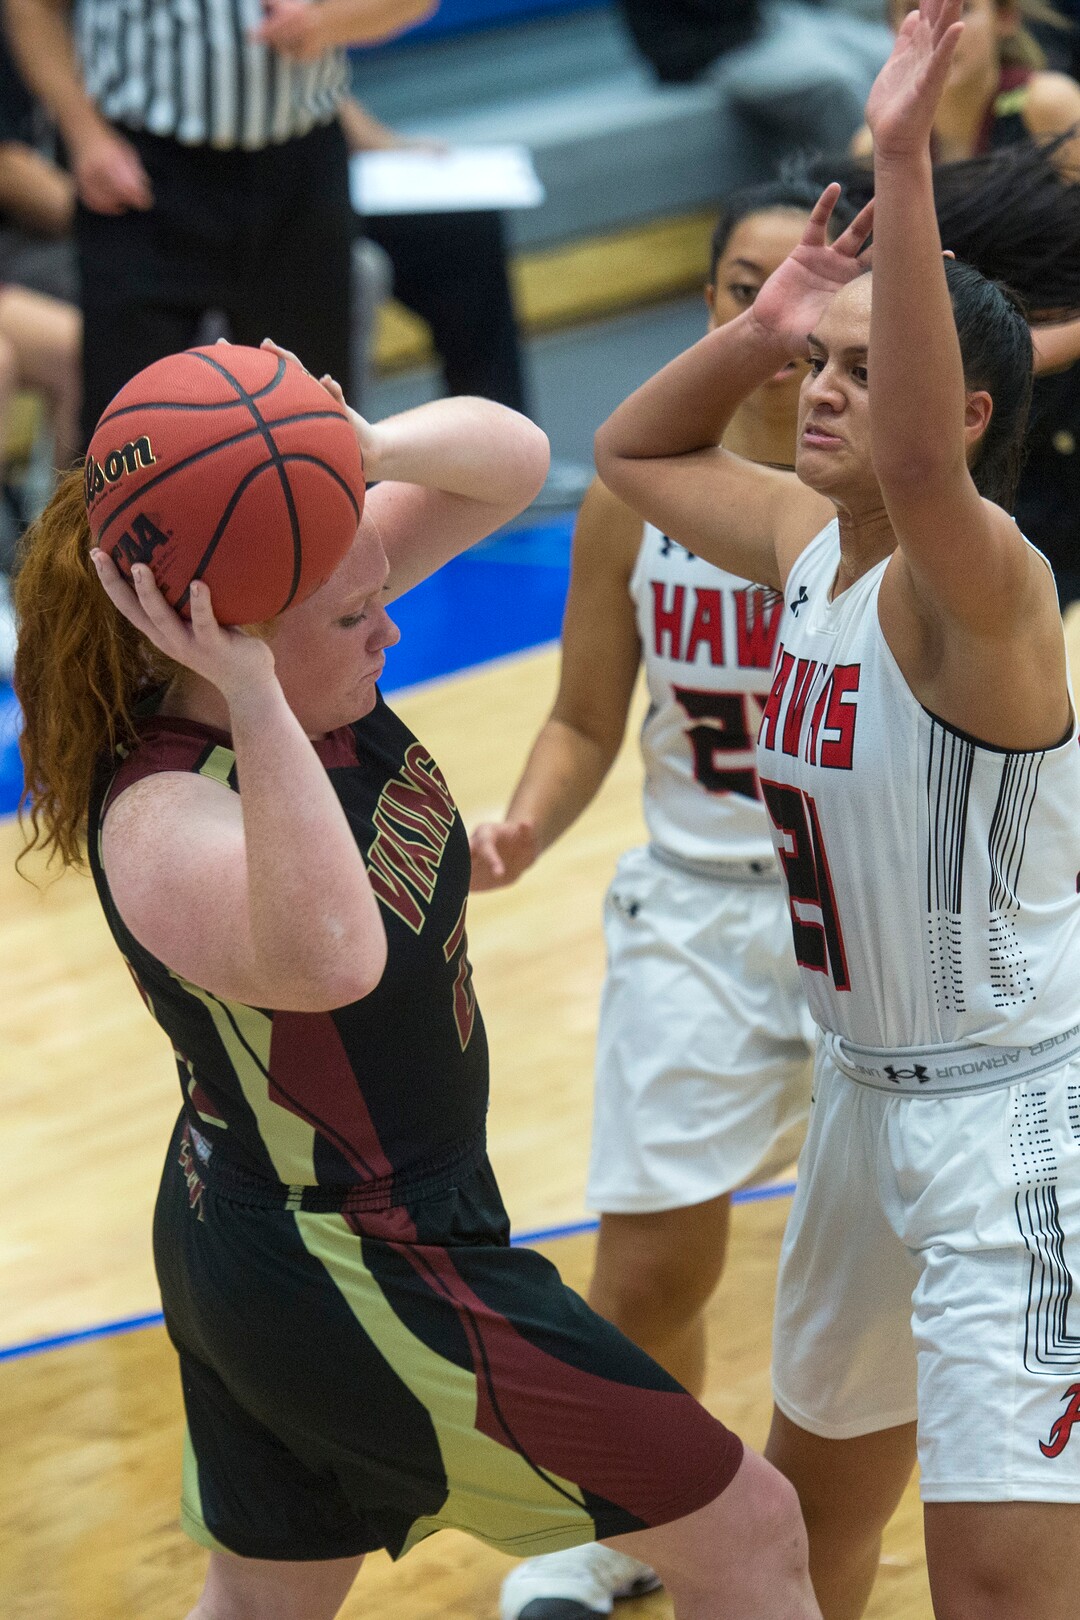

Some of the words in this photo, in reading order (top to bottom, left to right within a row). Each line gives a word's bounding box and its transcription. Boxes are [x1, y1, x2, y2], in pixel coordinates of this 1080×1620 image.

[84, 435, 156, 508] lson
[650, 580, 786, 670] HAW
[669, 681, 772, 803] 2
[757, 641, 861, 771] AWKS
[935, 1049, 1022, 1079] ARMOUR
[1027, 1023, 1080, 1057] NDER
